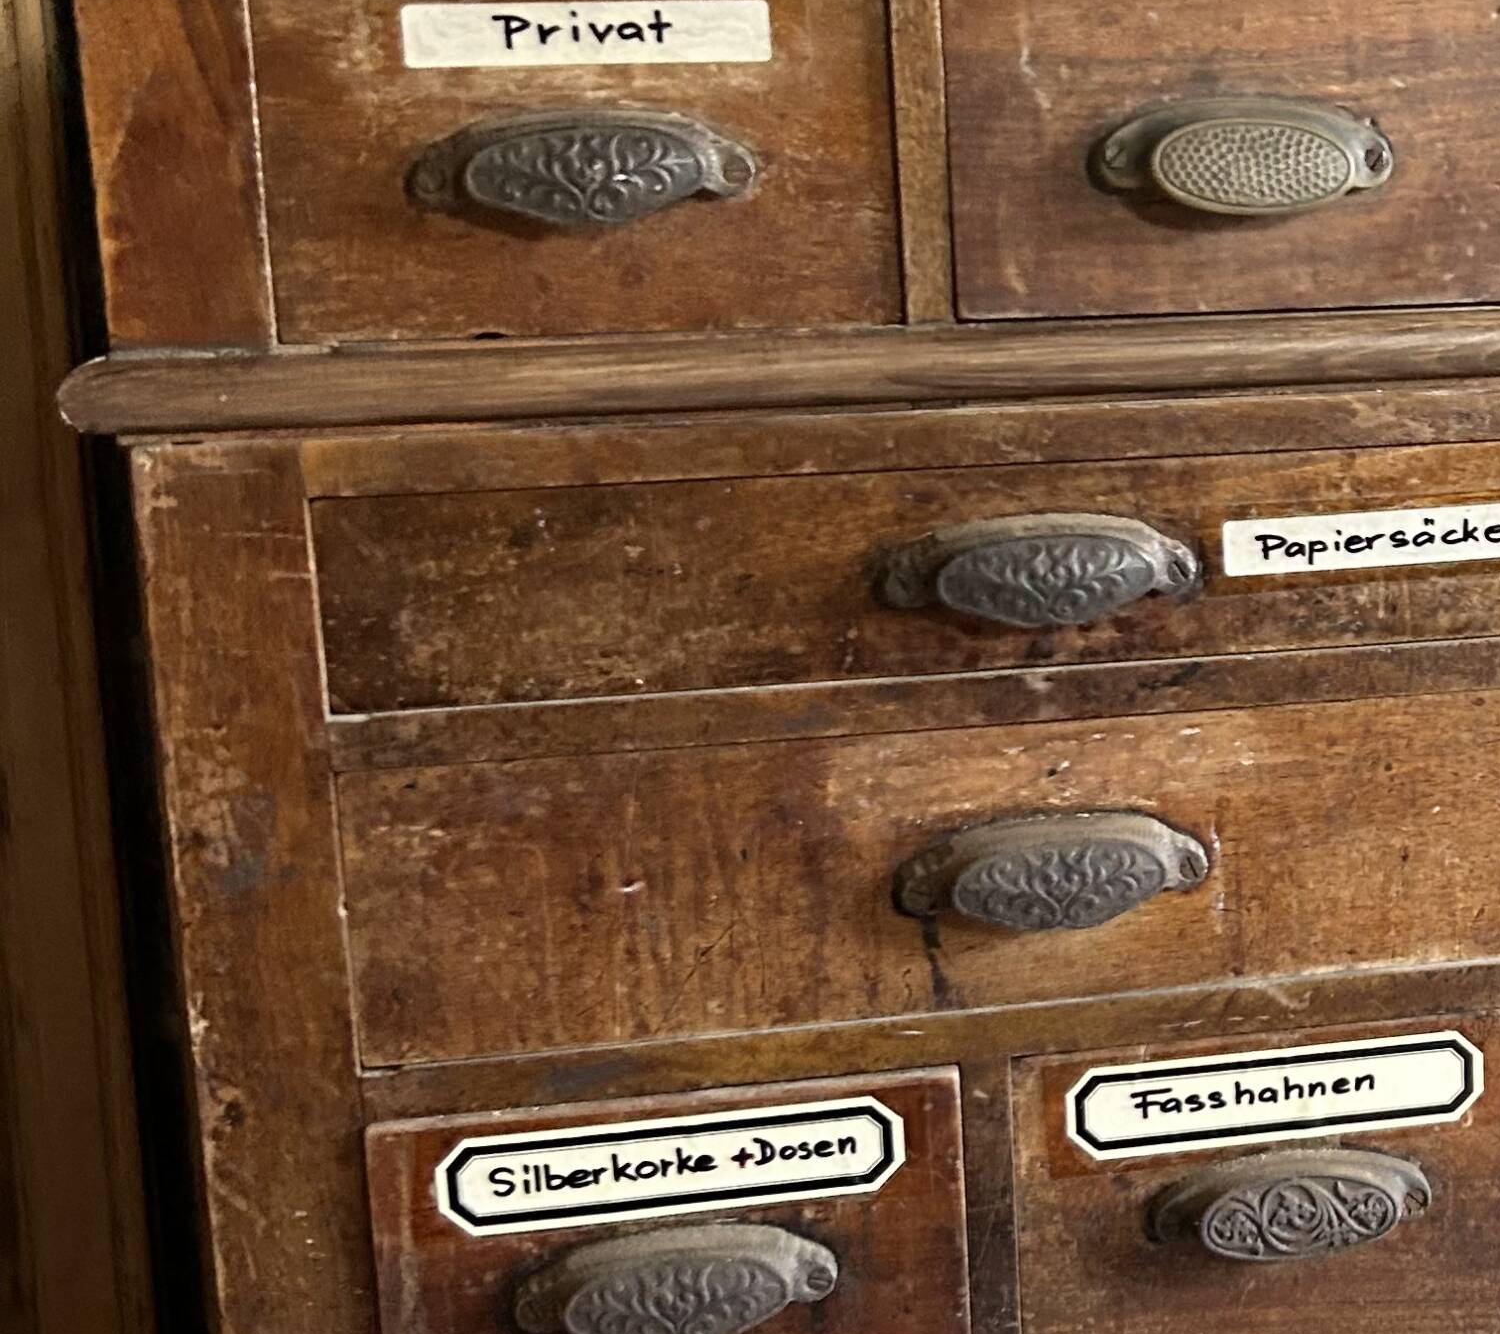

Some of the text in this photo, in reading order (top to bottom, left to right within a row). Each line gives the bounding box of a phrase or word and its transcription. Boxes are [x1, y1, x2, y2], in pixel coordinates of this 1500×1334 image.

[491, 9, 672, 50] Privat
[1130, 1073, 1376, 1120] Fasshahnen
[487, 1147, 717, 1197] Silberkorke
